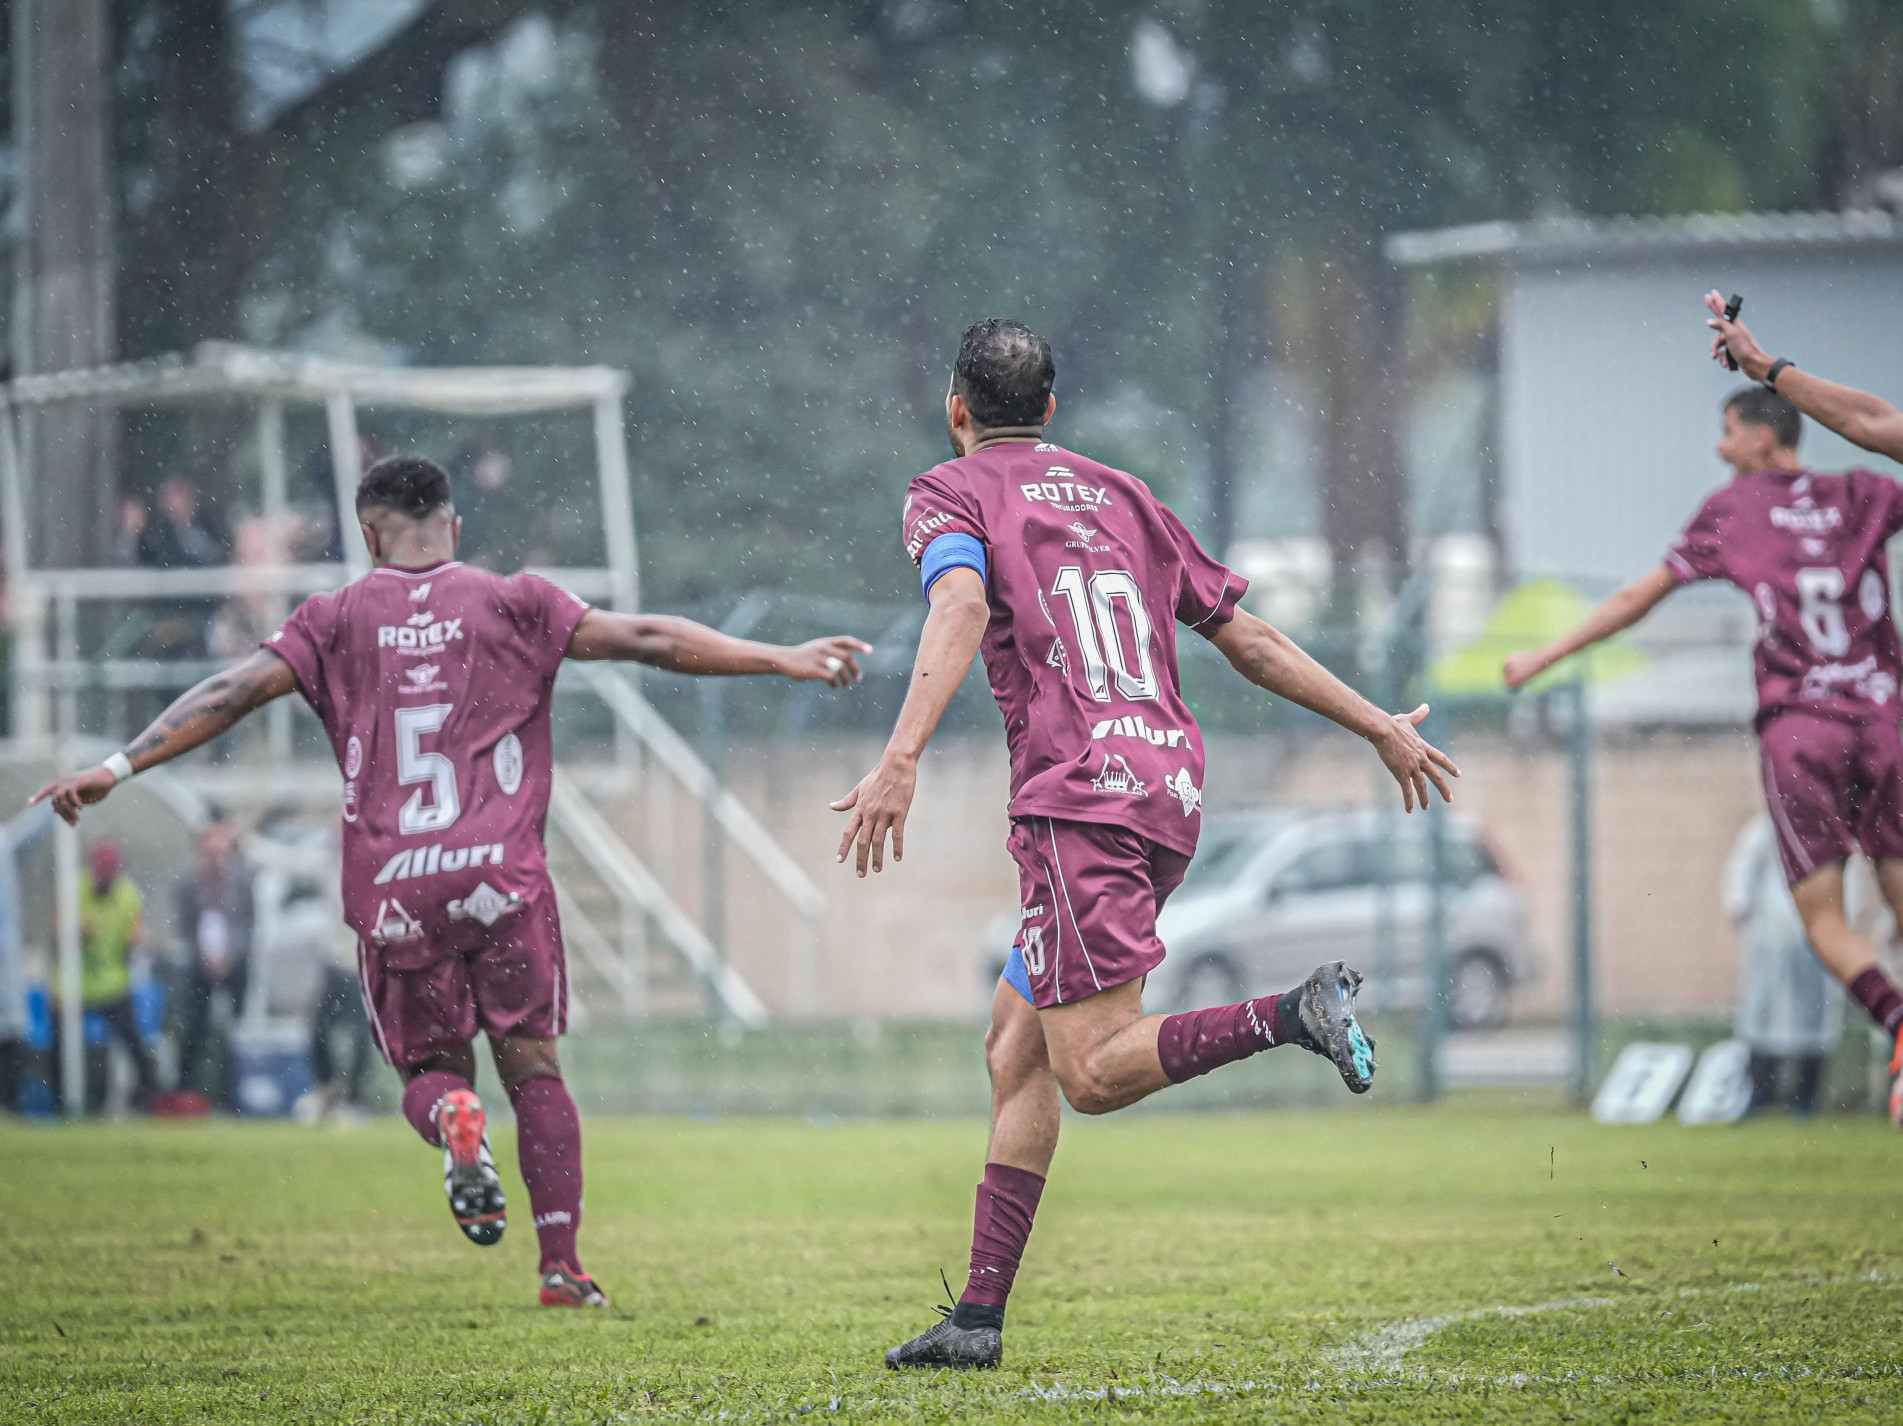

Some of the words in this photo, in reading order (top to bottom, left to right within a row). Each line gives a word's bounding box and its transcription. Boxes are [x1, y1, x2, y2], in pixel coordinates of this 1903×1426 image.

[1020, 482, 1112, 506] ROTEX
[378, 617, 464, 648] ROTEX
[1051, 566, 1160, 702] 10
[1795, 566, 1851, 657] 6
[394, 703, 461, 835] 5
